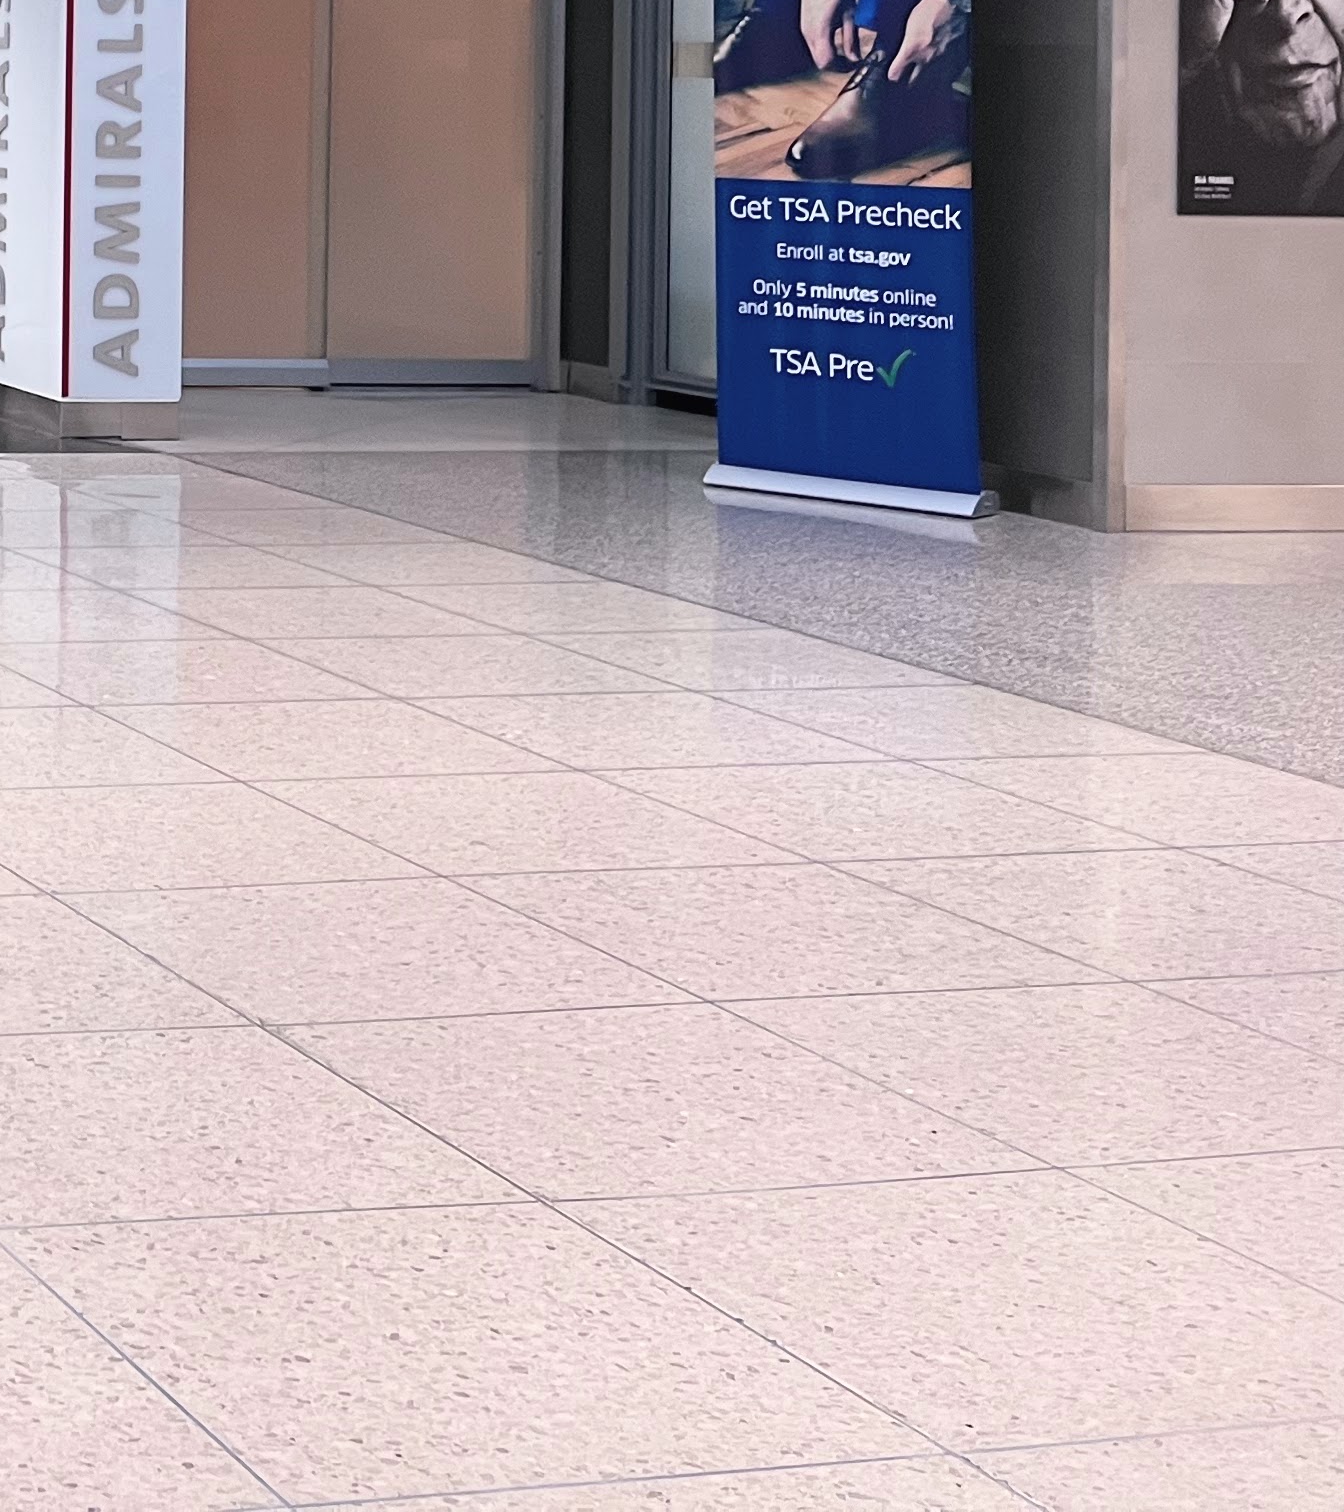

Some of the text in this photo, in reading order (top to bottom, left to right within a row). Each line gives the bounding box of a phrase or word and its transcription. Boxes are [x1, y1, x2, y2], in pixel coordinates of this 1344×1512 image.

[729, 195, 962, 230] Get TSA Precheck
[776, 242, 911, 267] Enroll at tsa.gov
[753, 278, 937, 307] Only 5 minutes online
[738, 300, 954, 331] and 10 minutes in person!
[769, 348, 875, 381] TSA Pre
